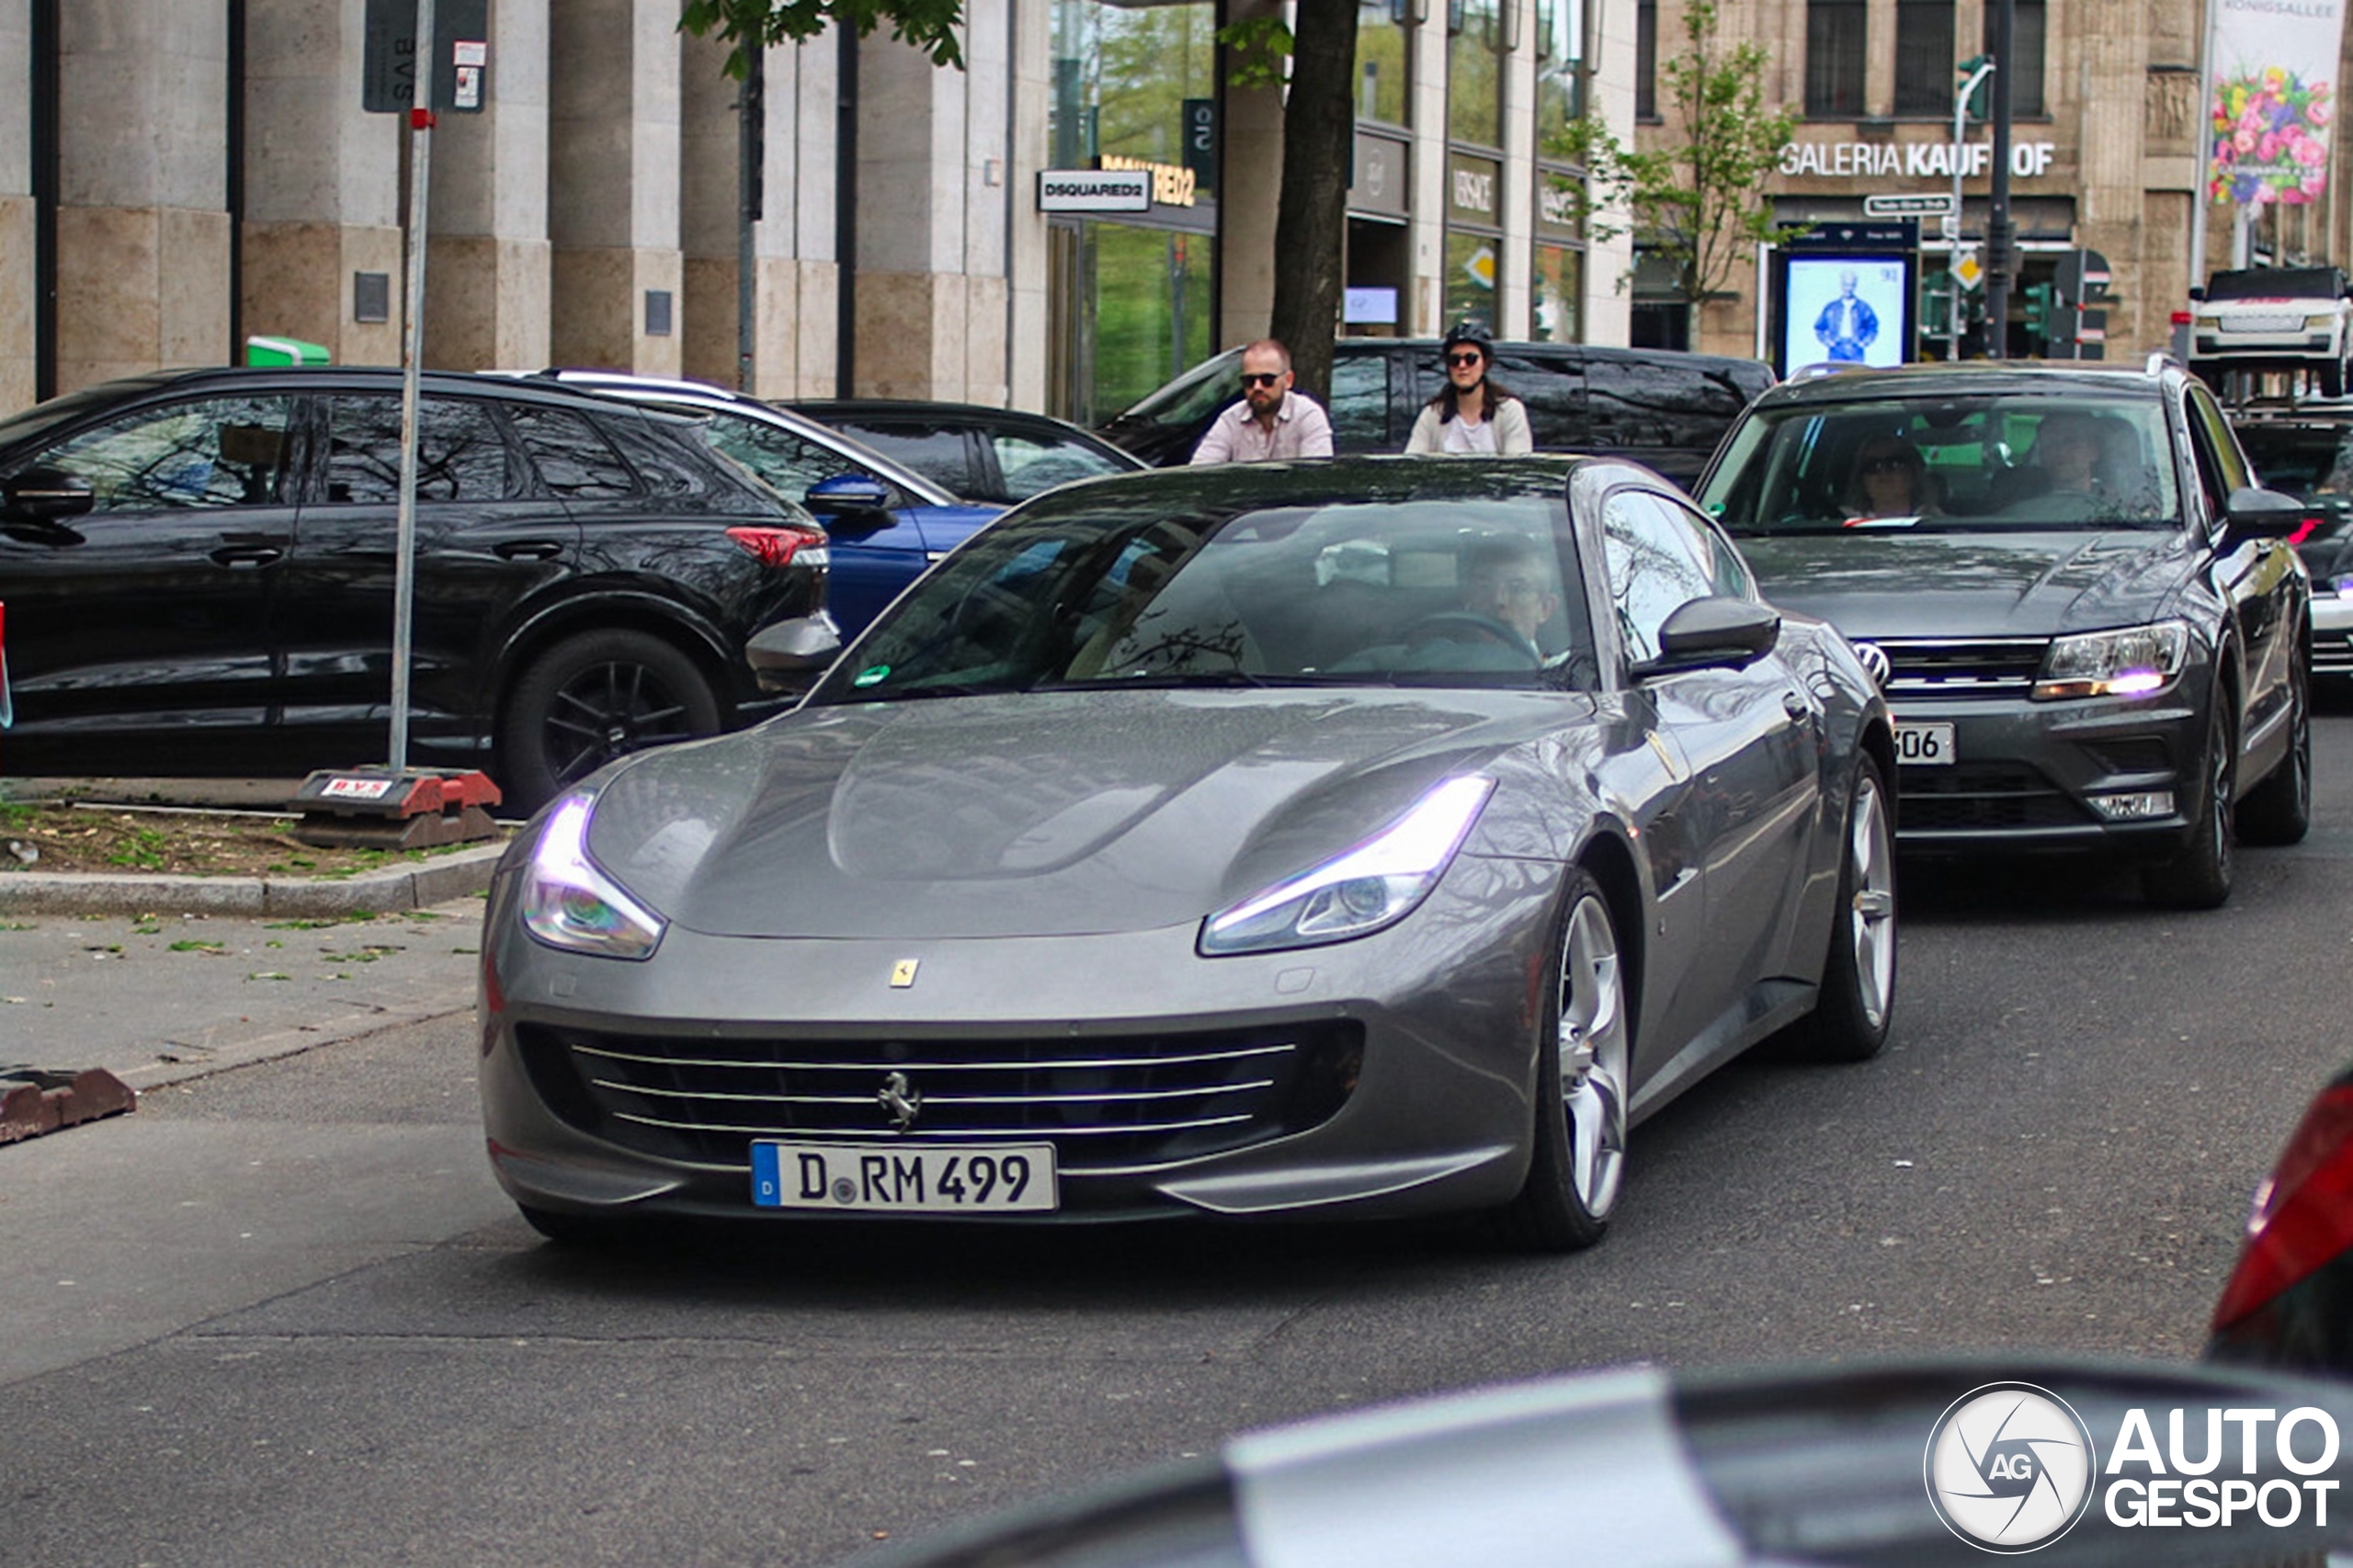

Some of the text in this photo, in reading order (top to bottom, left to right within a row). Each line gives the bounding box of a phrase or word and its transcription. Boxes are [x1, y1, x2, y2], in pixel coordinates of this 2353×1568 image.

[1779, 142, 2055, 176] GALERIA KAUFOF
[1045, 184, 1142, 197] DSQUARED2
[334, 781, 383, 790] BVS
[798, 1153, 1030, 1203] D RM 499
[762, 1182, 773, 1195] D
